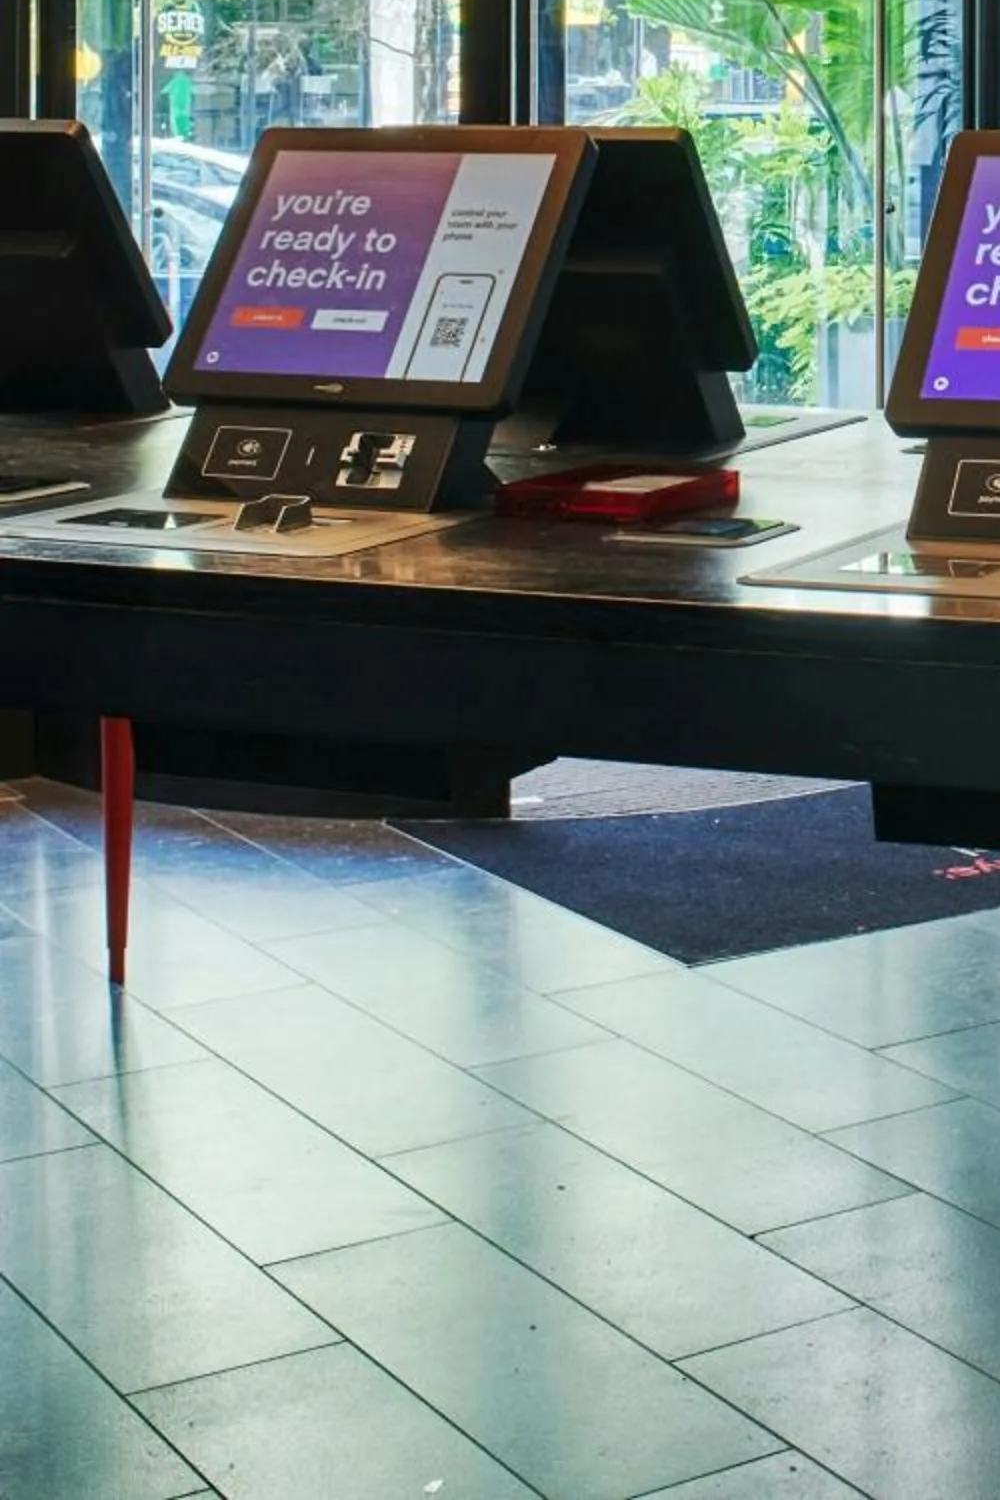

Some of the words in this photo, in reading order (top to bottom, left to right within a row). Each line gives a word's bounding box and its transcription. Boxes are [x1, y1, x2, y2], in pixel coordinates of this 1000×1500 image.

[272, 190, 372, 221] you're
[259, 224, 357, 260] ready
[363, 228, 398, 253] to
[247, 259, 387, 290] check-in
